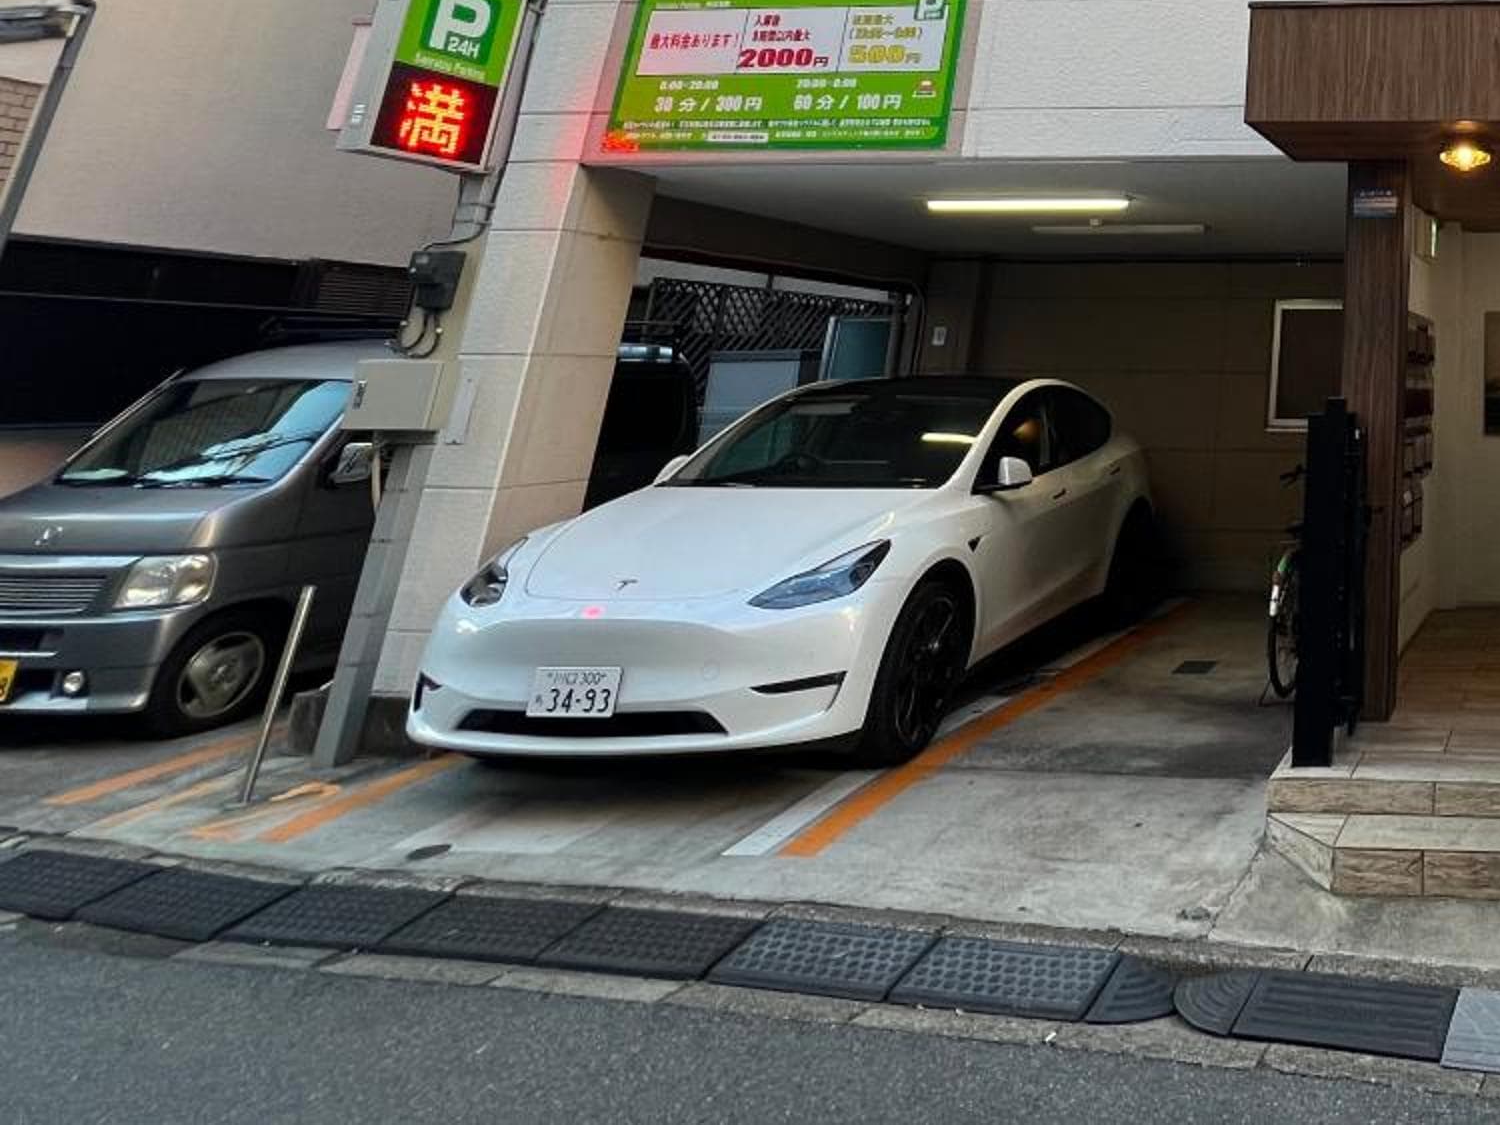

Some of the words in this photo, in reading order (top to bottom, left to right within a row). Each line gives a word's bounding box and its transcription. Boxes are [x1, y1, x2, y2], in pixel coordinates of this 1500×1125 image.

[447, 36, 480, 59] 24H
[737, 47, 829, 69] 2000円
[400, 81, 465, 155] 満
[546, 688, 611, 713] 34-93
